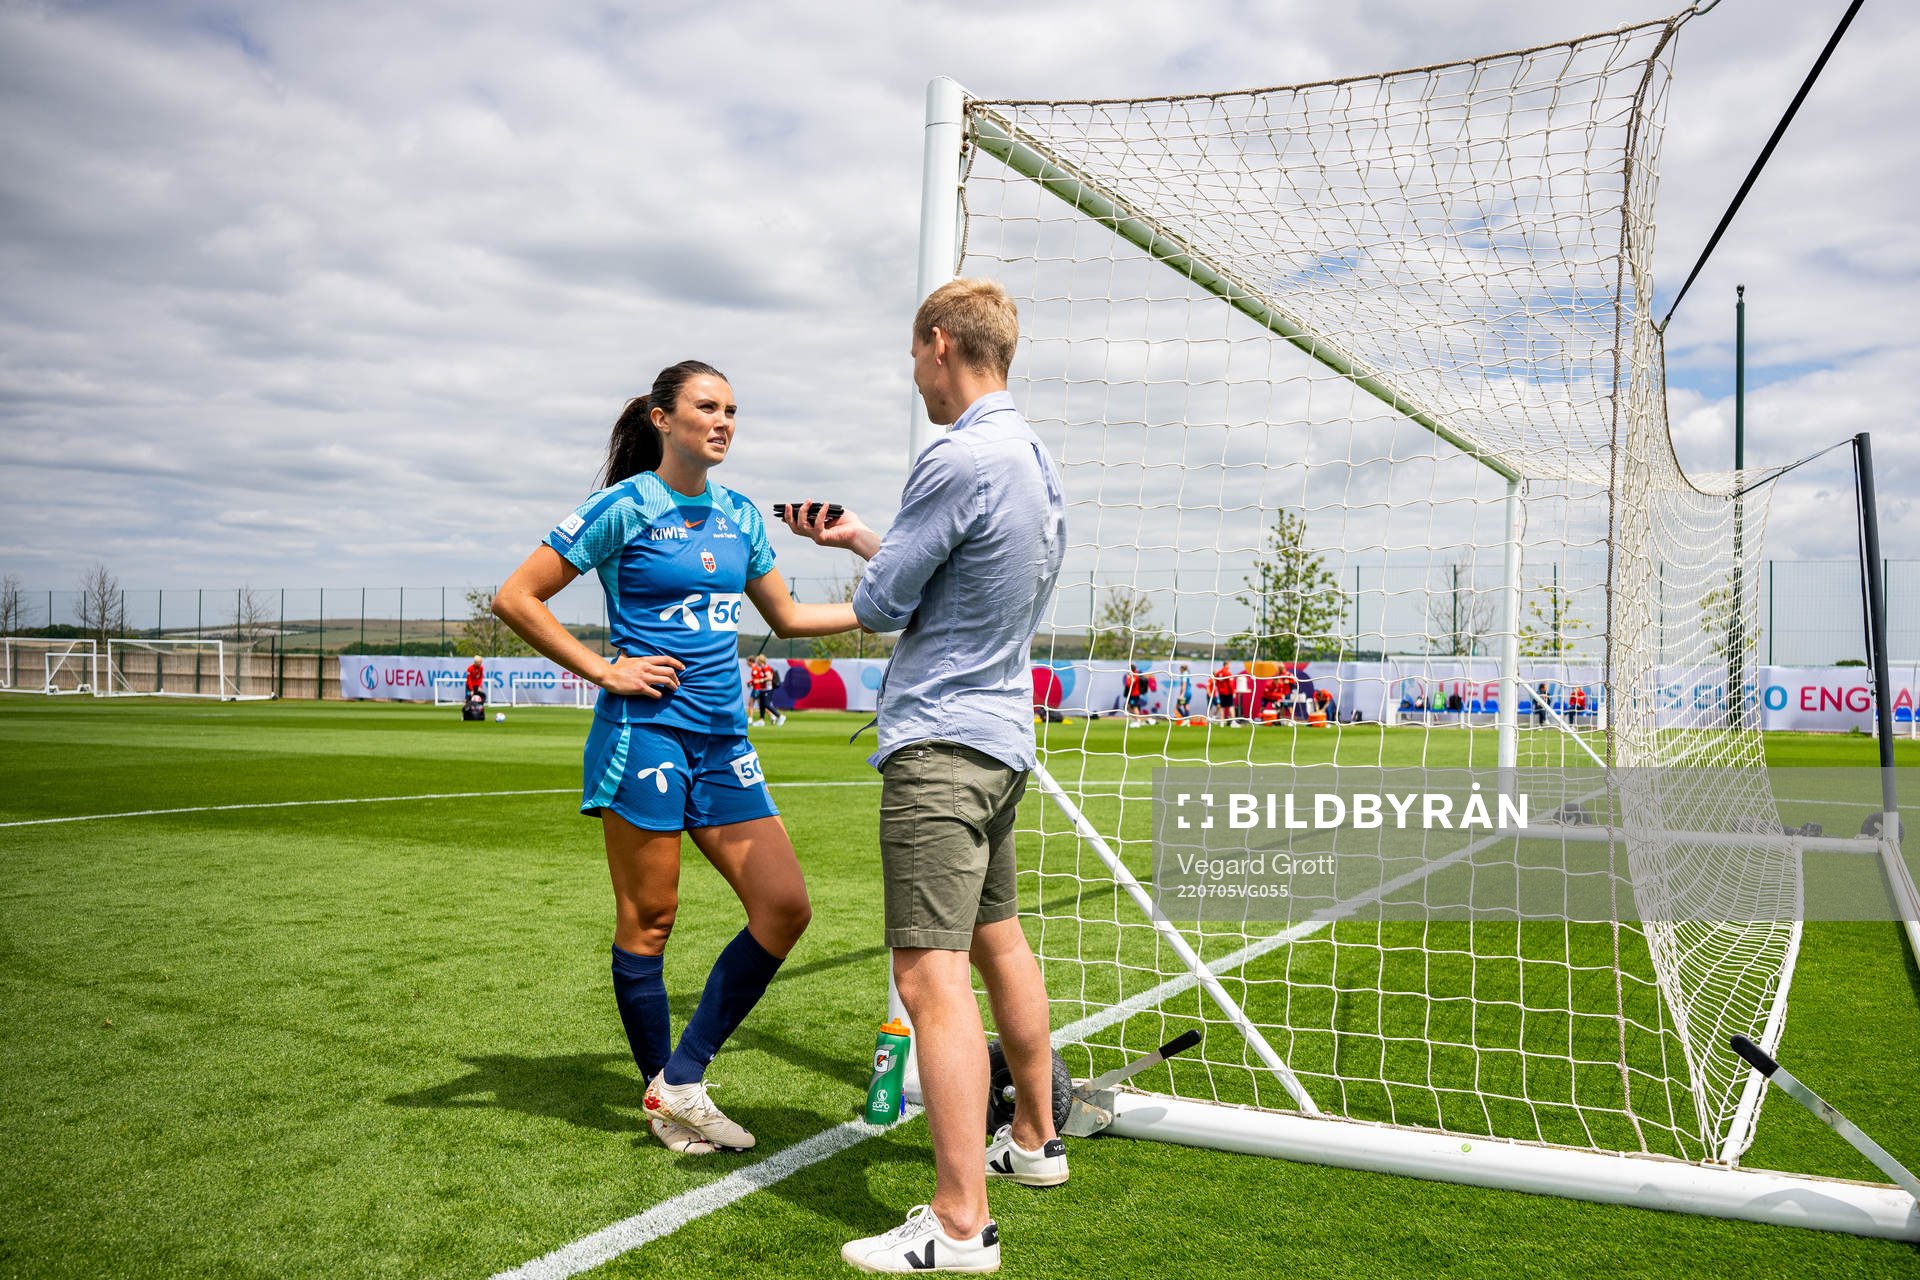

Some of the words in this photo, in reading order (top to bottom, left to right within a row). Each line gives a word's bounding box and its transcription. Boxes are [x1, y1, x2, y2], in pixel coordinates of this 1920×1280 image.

[651, 527, 678, 541] KIWI
[385, 668, 425, 687] UEFA
[427, 670, 504, 688] WOMN'S
[509, 671, 556, 689] EURO
